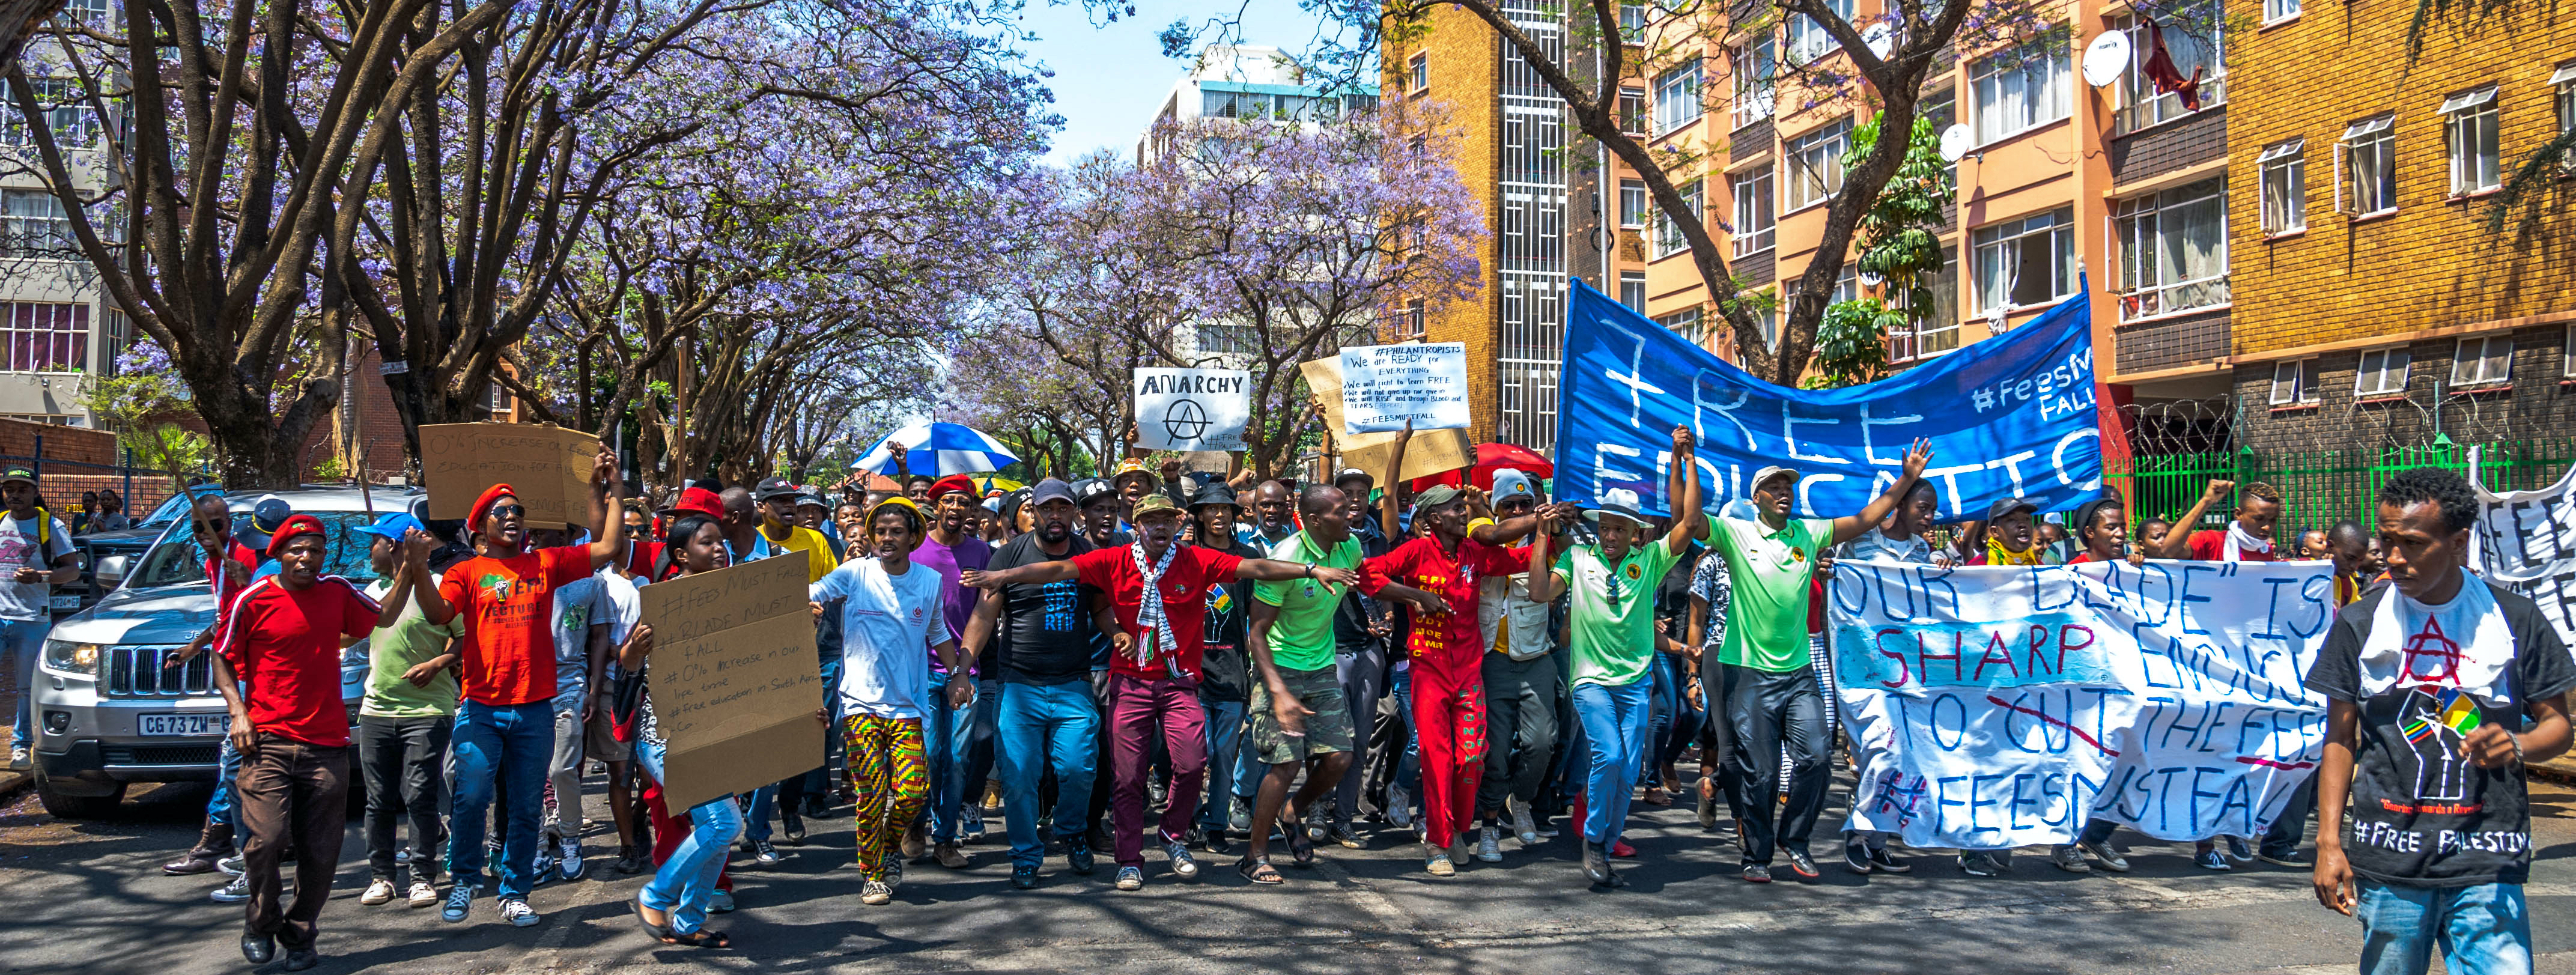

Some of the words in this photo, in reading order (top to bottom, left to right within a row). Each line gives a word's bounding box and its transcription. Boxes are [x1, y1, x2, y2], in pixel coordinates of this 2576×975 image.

[1375, 345, 1460, 357] #PHILANTROPISTS
[1350, 357, 1368, 368] We
[1391, 354, 1422, 364] READY
[1379, 367, 1429, 375] EVERYTHING
[1140, 375, 1243, 395] ANARCHY
[1363, 379, 1375, 387] will
[1408, 395, 1428, 404] through
[1362, 413, 1436, 424] #FEESMUSTFALL
[469, 433, 543, 451] INCREASE
[436, 461, 525, 473] EDUCATION
[2479, 494, 2576, 574] #FEE
[515, 577, 545, 595] EFF
[726, 571, 770, 596] MUST
[776, 565, 806, 584] FALL
[745, 595, 791, 623] MUST
[1045, 596, 1078, 612] SPO
[1833, 562, 1960, 622] OUR
[2251, 574, 2332, 640] IS
[1045, 613, 1075, 631] RTIF
[185, 630, 201, 640] Je
[1876, 624, 2095, 688] SHARP
[711, 688, 753, 706] education
[757, 684, 767, 693] in
[771, 677, 796, 691] South
[145, 717, 165, 733] CG
[168, 717, 186, 733] 73
[190, 715, 208, 733] ZW
[221, 715, 232, 732] G
[1886, 693, 1967, 752] TO
[2004, 687, 2134, 757] CUT
[2144, 696, 2234, 752] THE
[2237, 706, 2327, 762] FEES
[2446, 806, 2452, 815] a
[2354, 819, 2422, 853] #FREE
